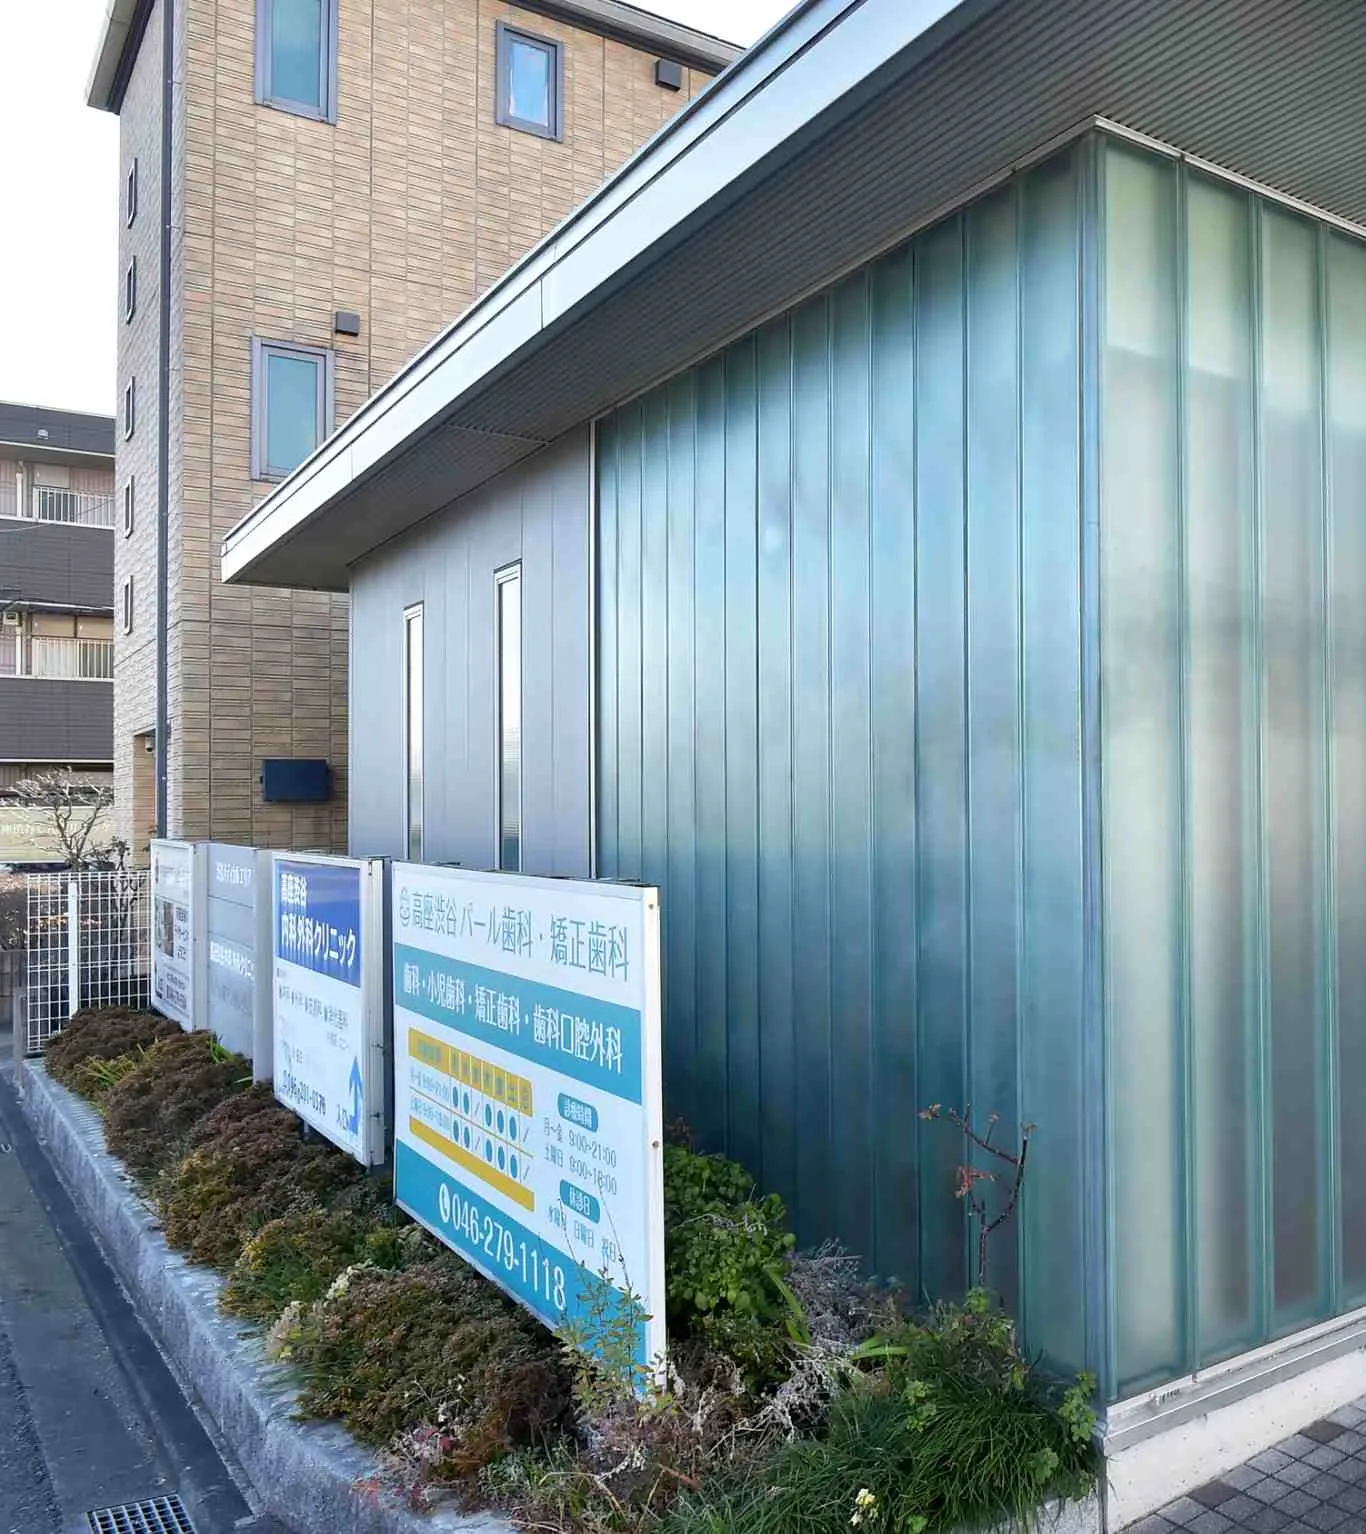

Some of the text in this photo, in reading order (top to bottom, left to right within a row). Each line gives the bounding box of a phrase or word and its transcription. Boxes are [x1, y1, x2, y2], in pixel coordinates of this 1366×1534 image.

[282, 912, 355, 968] 内科外科クリニック
[452, 1193, 566, 1310] 046-279-1118
